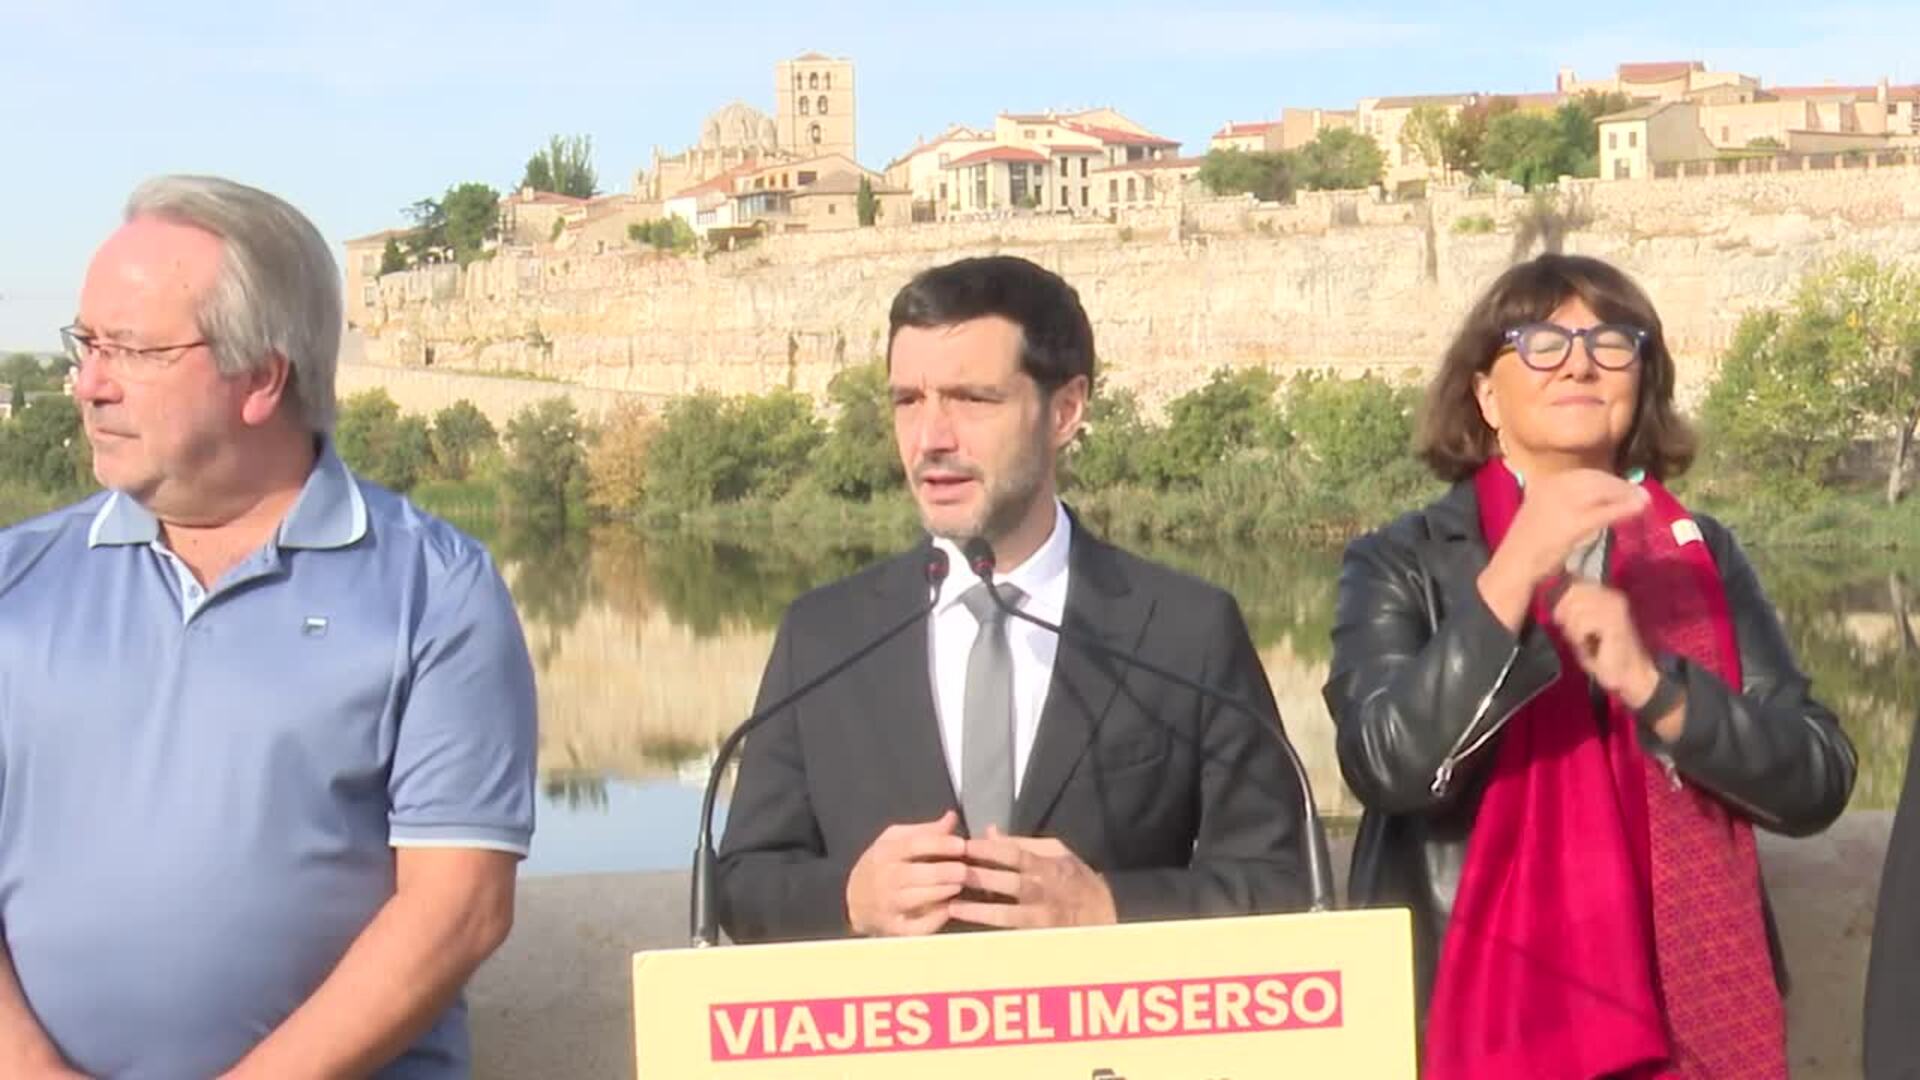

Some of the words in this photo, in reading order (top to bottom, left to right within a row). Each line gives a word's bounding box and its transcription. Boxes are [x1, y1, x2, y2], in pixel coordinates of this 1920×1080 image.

[714, 999, 932, 1055] VIAJES
[948, 994, 1054, 1043] DEL
[1069, 977, 1337, 1036] IMSERSO
